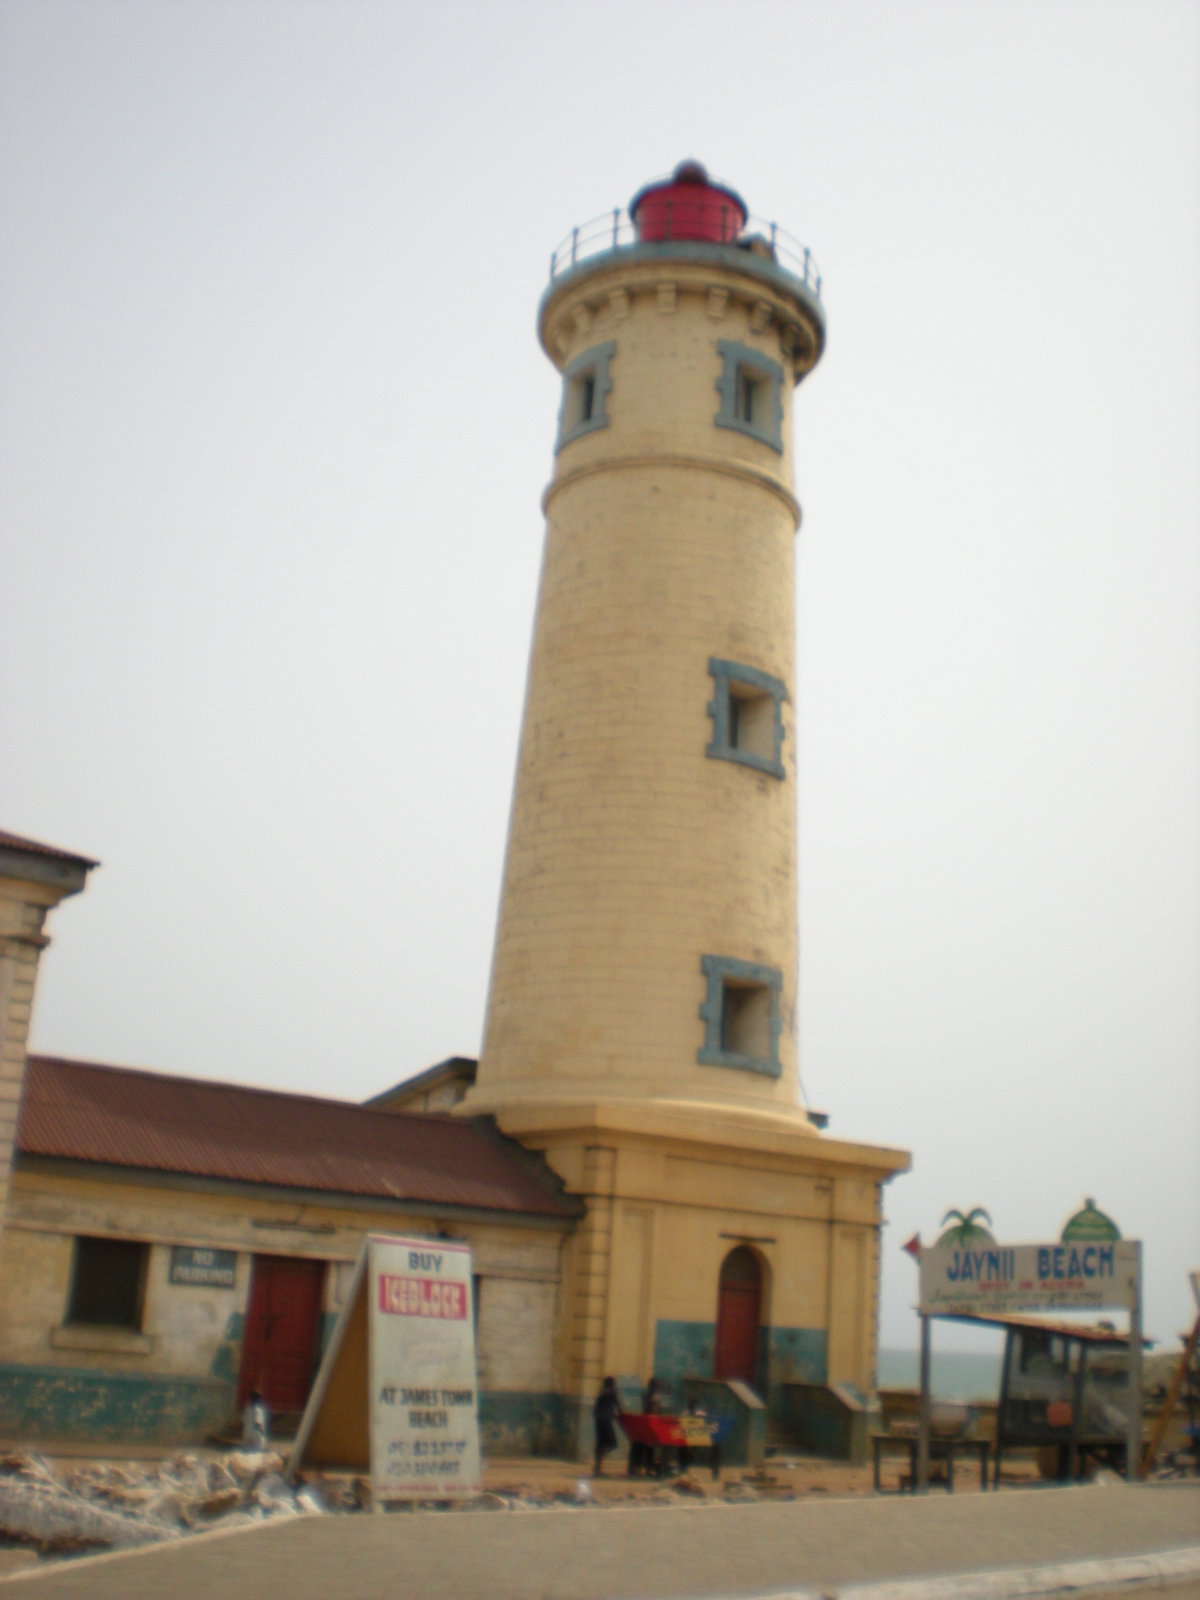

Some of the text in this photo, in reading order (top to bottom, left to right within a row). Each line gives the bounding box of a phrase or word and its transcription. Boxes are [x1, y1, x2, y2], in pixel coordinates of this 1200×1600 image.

[192, 1249, 216, 1267] NO
[407, 1251, 443, 1273] BUY
[946, 1246, 1115, 1282] JAYNII BEACH
[173, 1265, 234, 1286] PARKING
[379, 1386, 397, 1405] AT
[408, 1410, 448, 1429] BEACH
